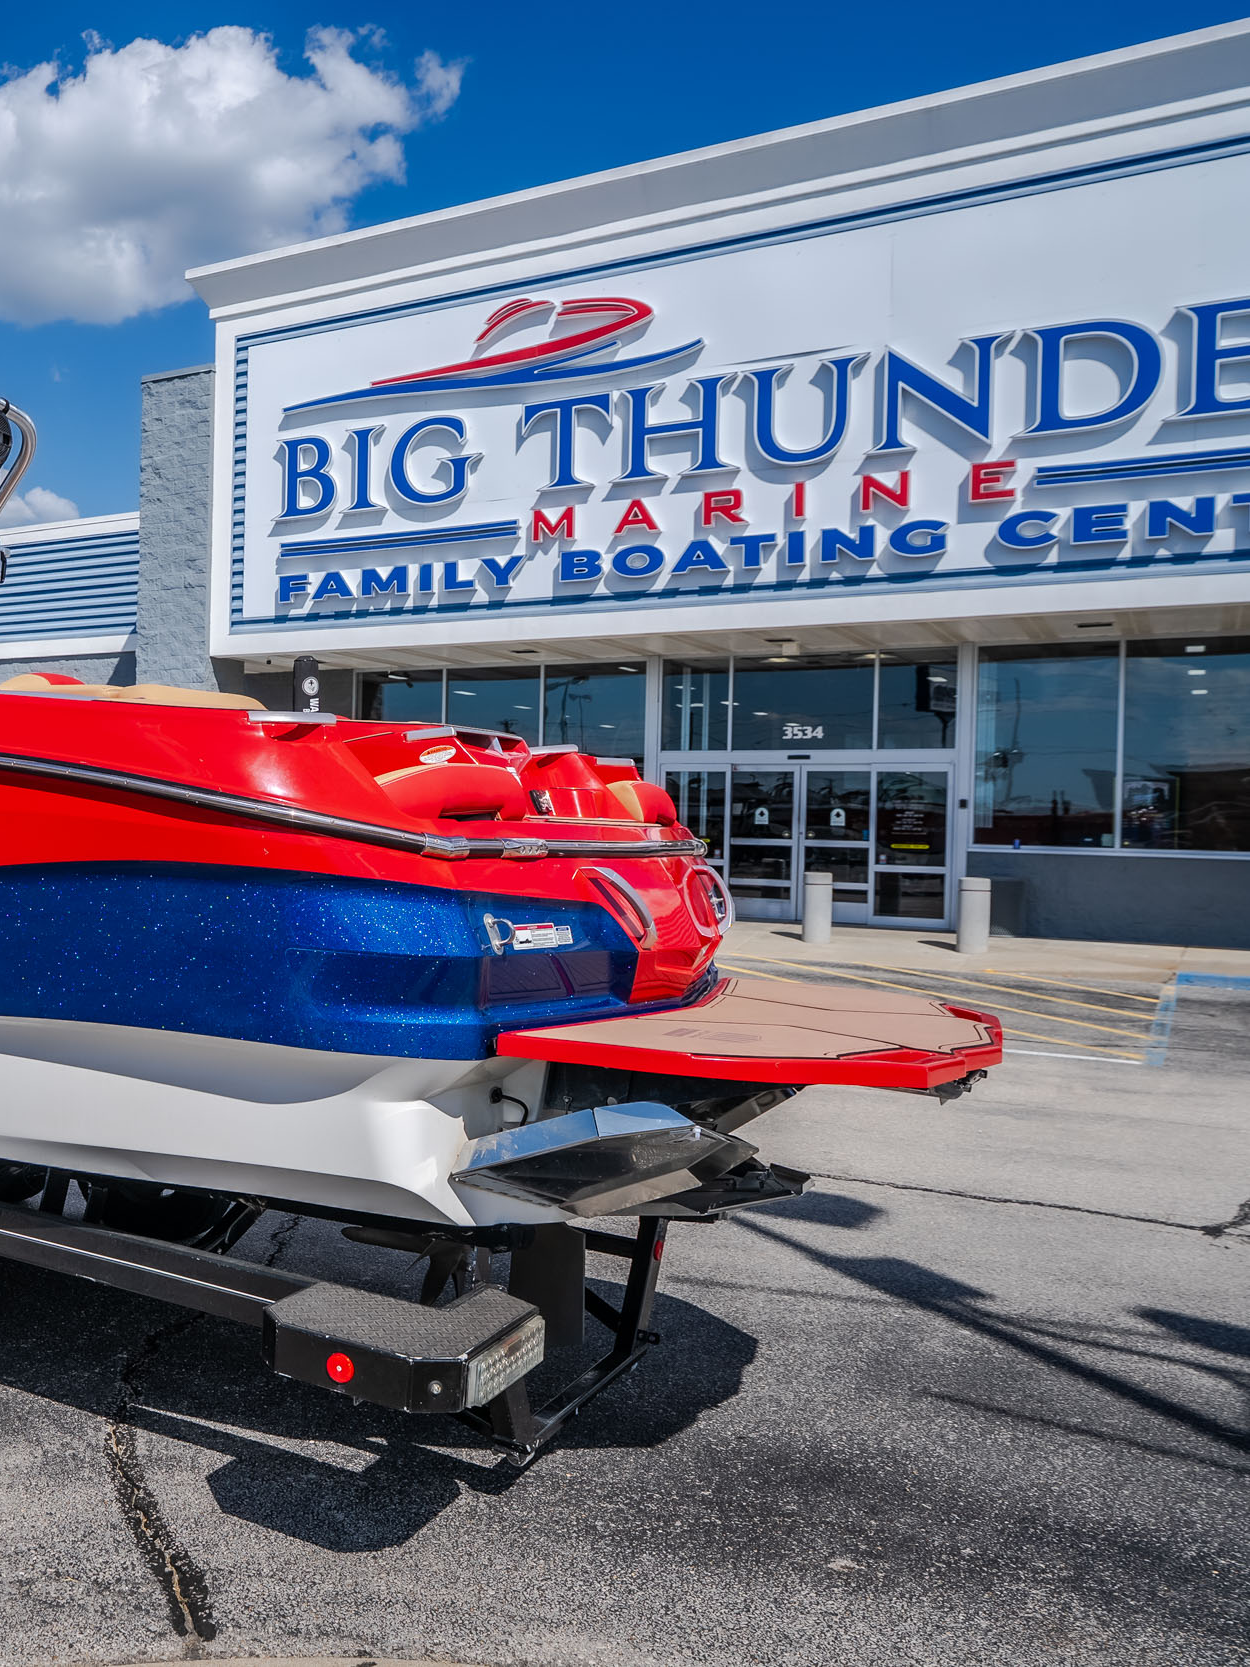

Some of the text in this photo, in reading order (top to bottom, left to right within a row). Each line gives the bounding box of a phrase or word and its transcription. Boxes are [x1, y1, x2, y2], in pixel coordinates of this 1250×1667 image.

[271, 294, 1250, 522] BIG THUNDE
[531, 459, 1017, 543] MARINE
[278, 554, 529, 603] FAMILY
[558, 518, 950, 582] BOATING
[310, 698, 319, 712] WA
[781, 725, 824, 740] 3534
